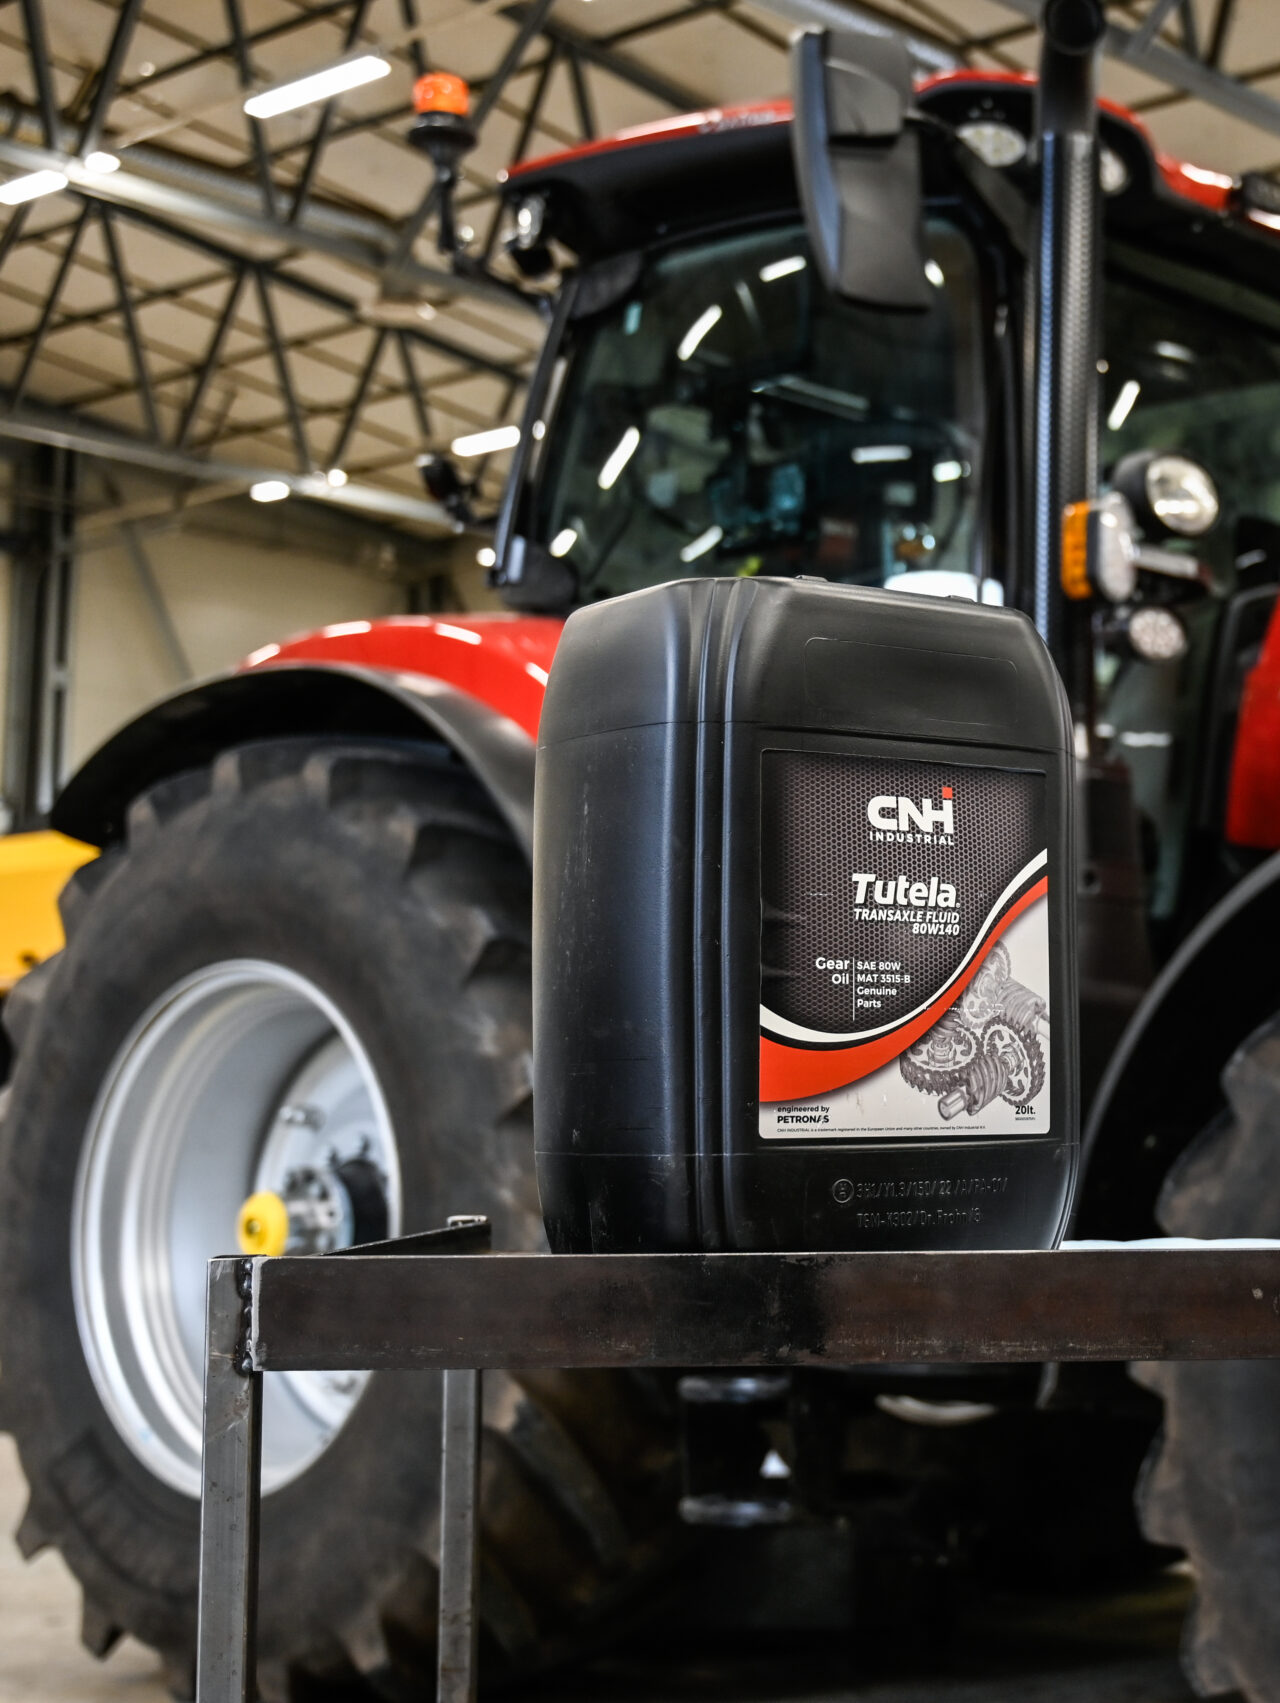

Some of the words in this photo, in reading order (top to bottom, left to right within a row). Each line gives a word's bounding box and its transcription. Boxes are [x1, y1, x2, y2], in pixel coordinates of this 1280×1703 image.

[869, 831, 955, 846] INDUSTRIAL
[852, 873, 957, 908] Tutela
[854, 908, 923, 922] TRANSAXLE
[926, 911, 960, 924] FLUID
[912, 922, 960, 936] 80W140
[815, 957, 850, 970] Gear
[856, 961, 877, 971] SAE
[878, 961, 901, 971] 80W
[831, 973, 849, 985] Oil
[856, 974, 878, 983] MAT
[856, 986, 898, 996] Genuine
[857, 998, 882, 1008] Parts
[777, 1105, 819, 1114] engineered
[820, 1105, 830, 1113] by
